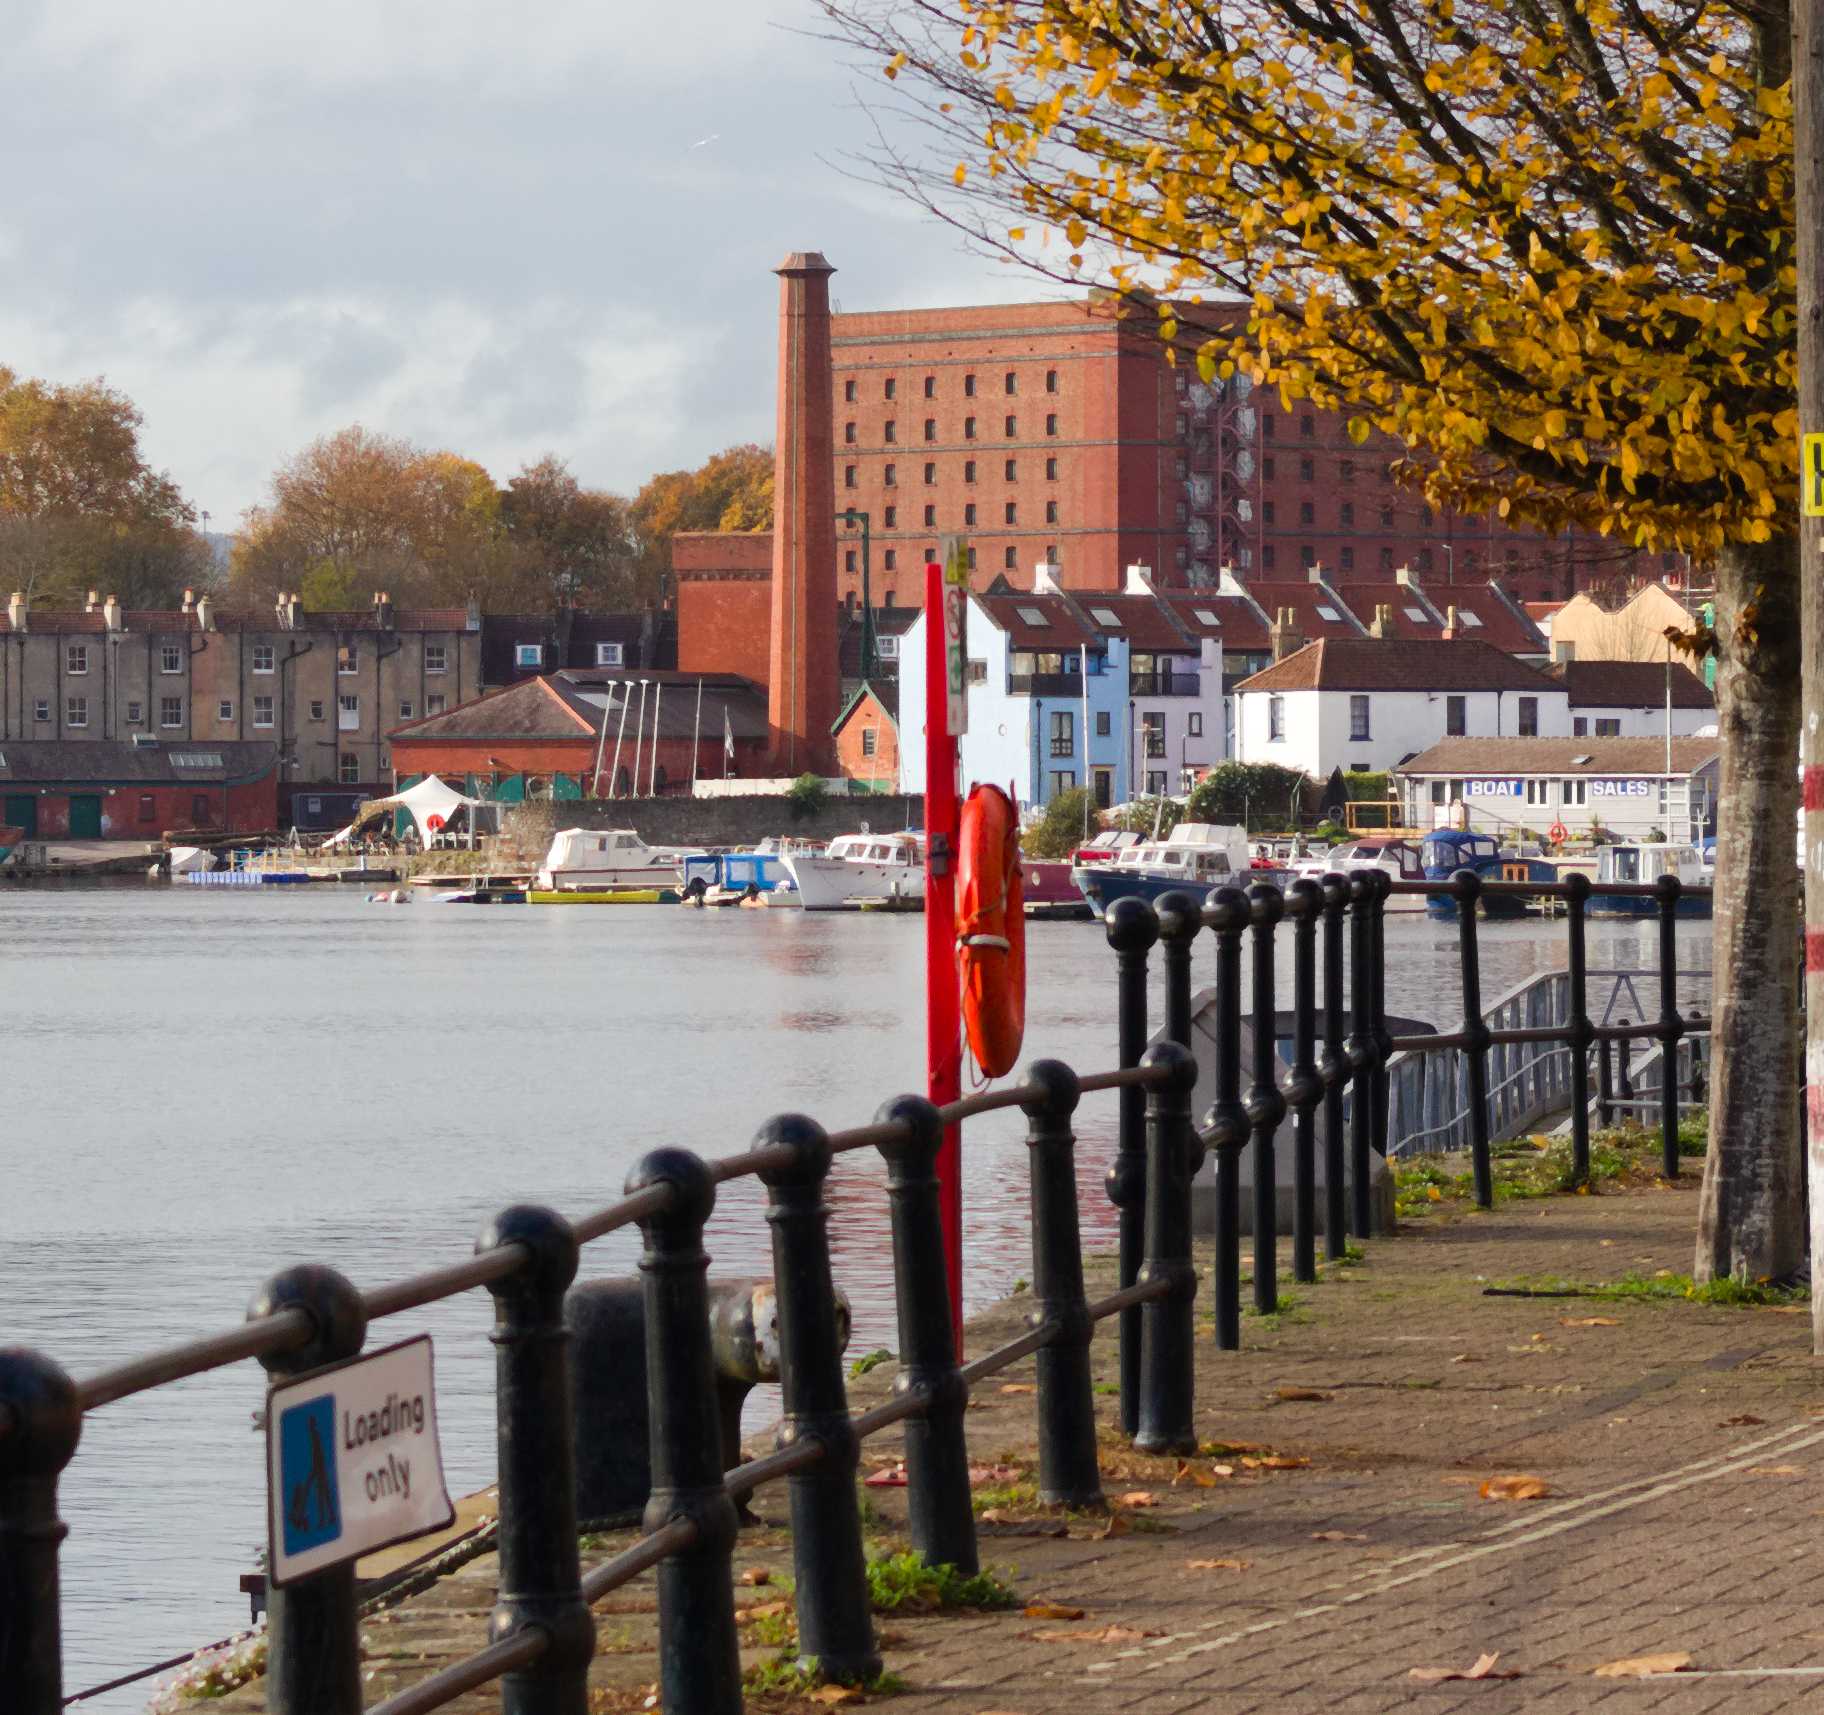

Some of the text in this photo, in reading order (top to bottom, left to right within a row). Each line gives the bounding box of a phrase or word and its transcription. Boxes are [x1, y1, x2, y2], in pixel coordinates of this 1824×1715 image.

[1471, 780, 1648, 796] BOAT SALES
[344, 1393, 424, 1450] Loading
[364, 1452, 411, 1502] only
